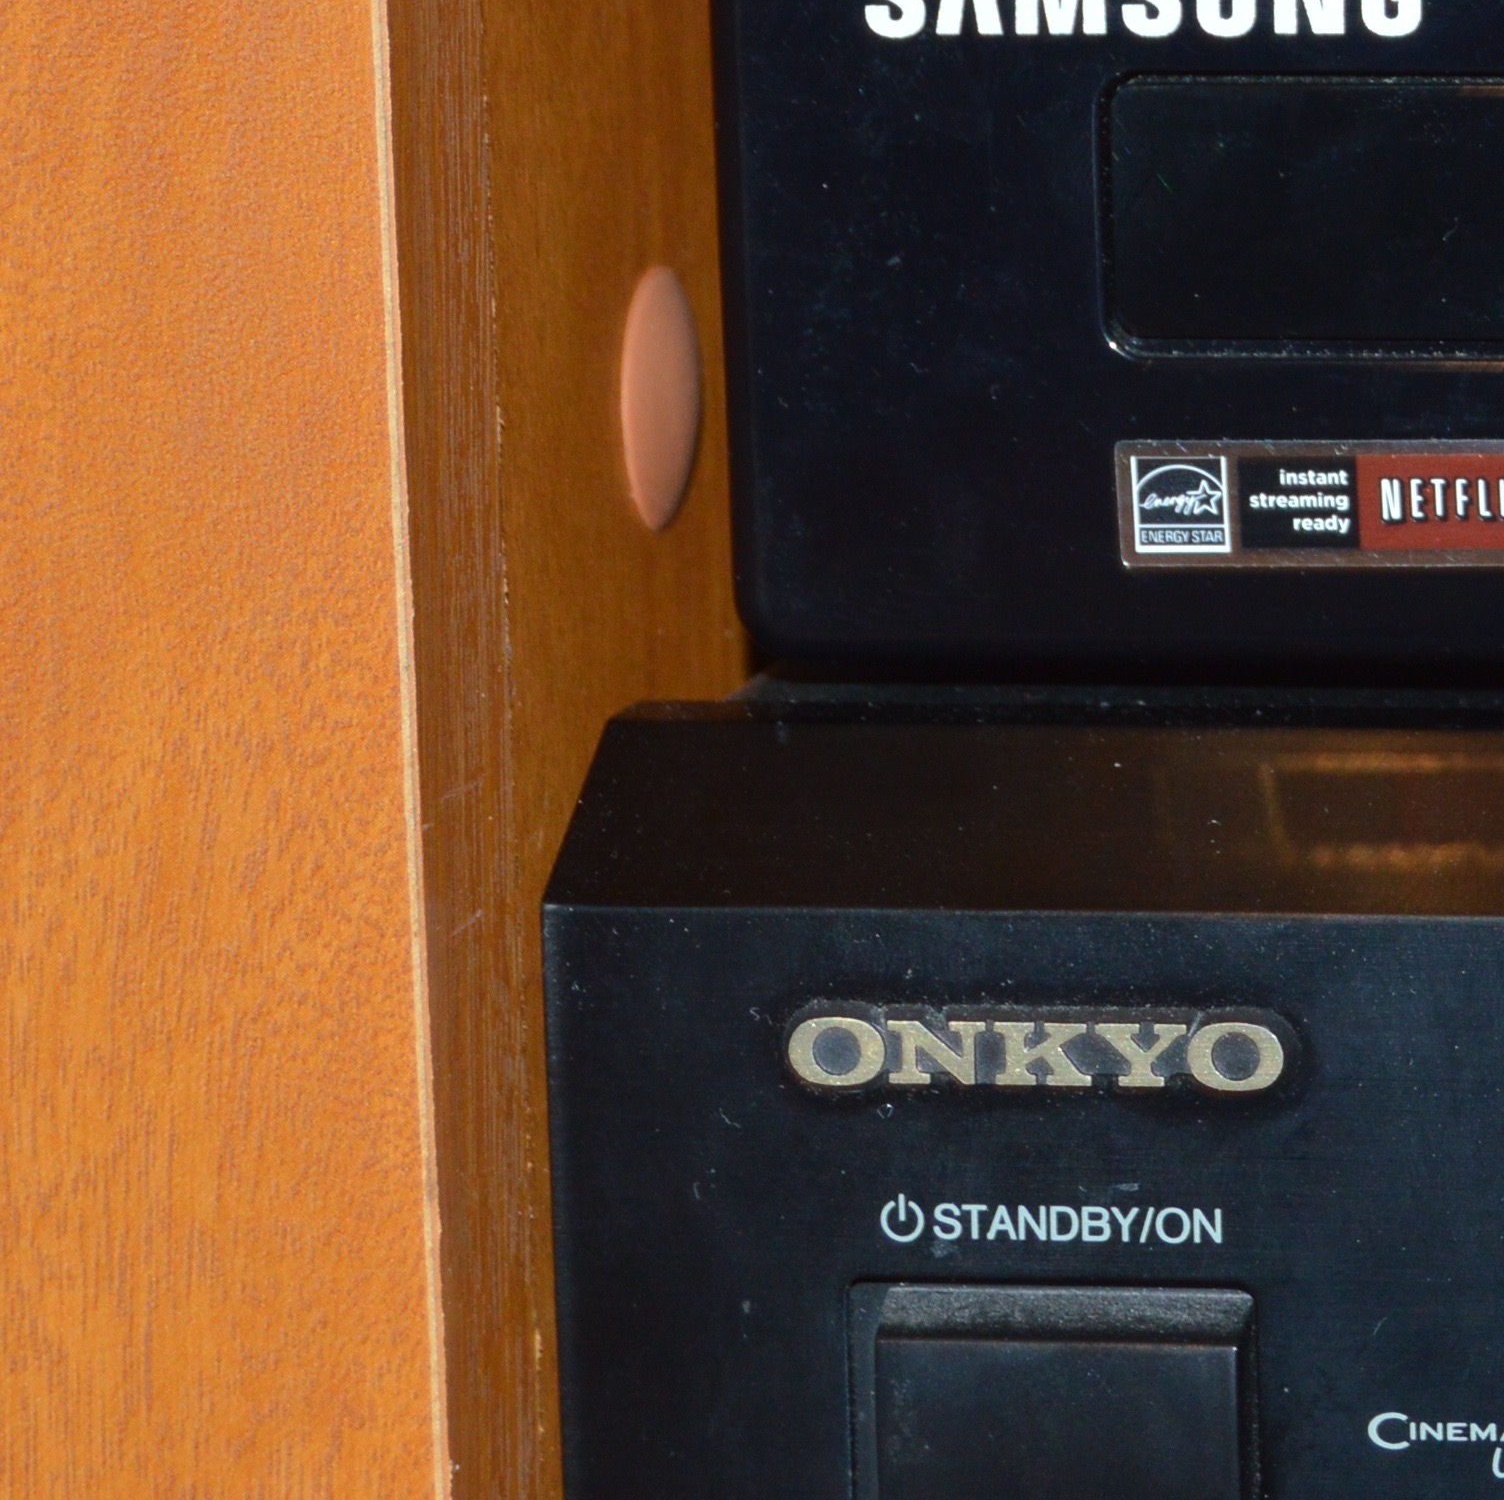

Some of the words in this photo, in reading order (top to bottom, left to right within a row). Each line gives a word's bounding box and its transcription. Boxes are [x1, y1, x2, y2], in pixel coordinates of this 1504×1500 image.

[1279, 469, 1348, 485] instant
[1249, 492, 1349, 511] streaming
[1293, 515, 1350, 533] ready
[1141, 530, 1189, 544] ENERGY
[1192, 530, 1224, 544] STAR
[788, 1016, 1285, 1092] ONKYO
[932, 1203, 1223, 1245] STANDBY/ON
